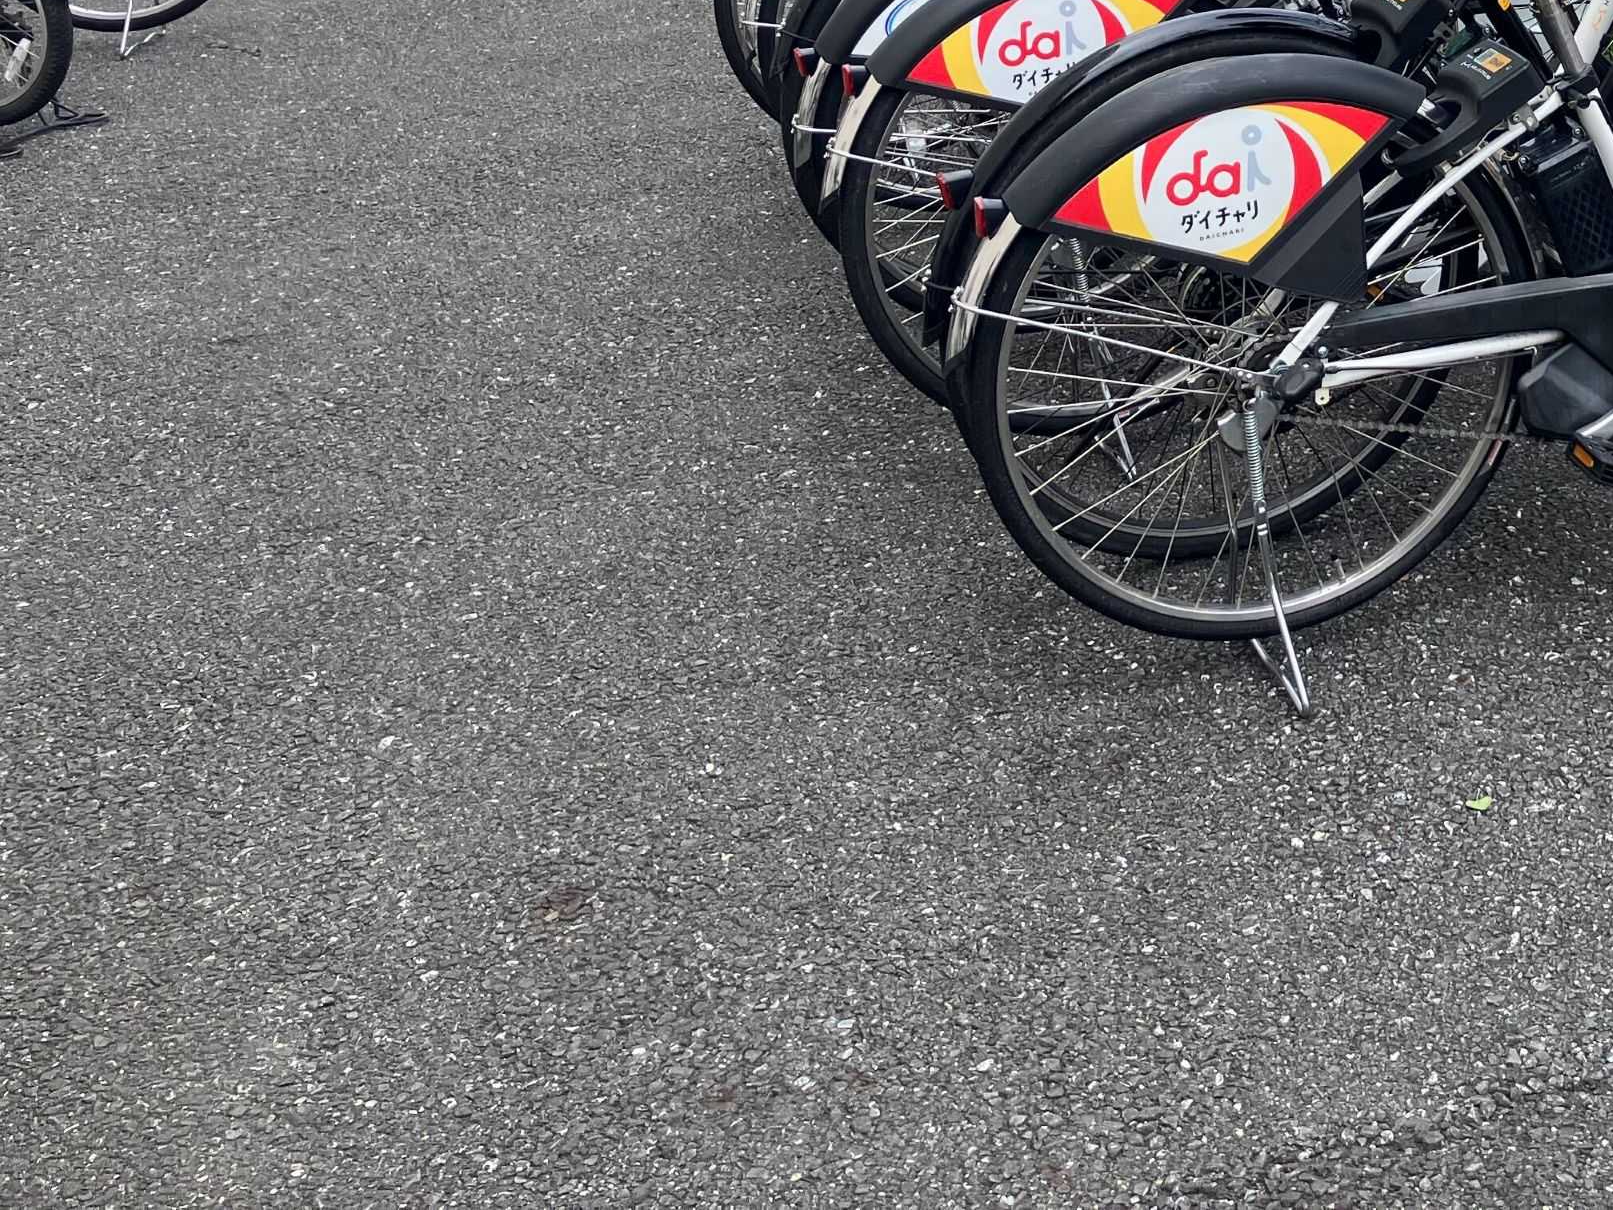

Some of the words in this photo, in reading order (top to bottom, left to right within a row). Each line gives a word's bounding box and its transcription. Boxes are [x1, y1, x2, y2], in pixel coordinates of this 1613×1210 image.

[999, 0, 1087, 67] dai
[1166, 124, 1272, 206] dai
[1181, 200, 1259, 234] ダイチャリ
